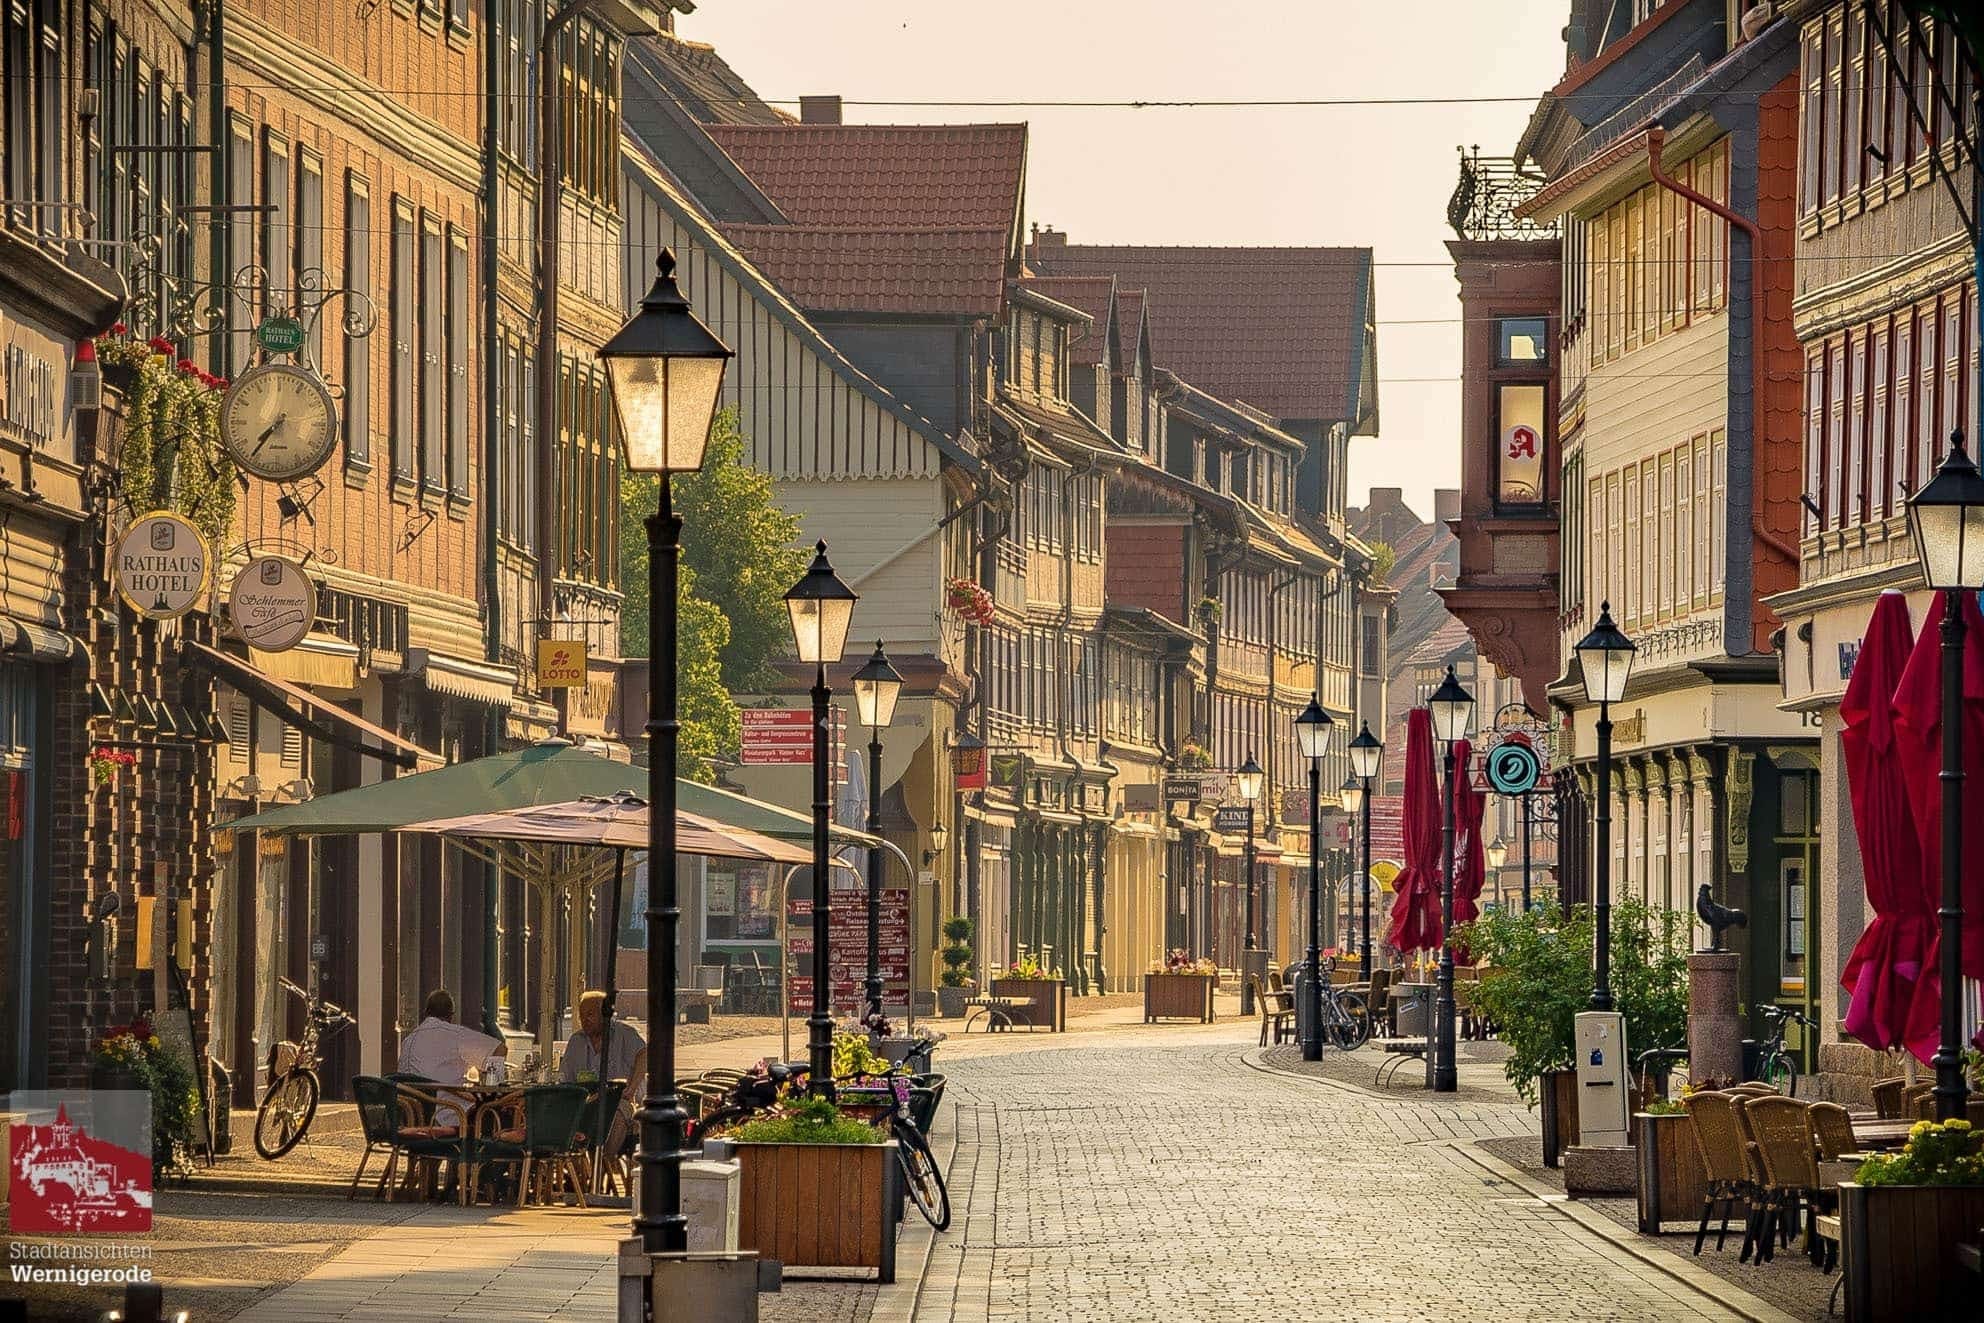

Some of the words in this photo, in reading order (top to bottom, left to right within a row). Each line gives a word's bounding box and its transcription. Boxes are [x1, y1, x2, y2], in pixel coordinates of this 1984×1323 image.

[265, 334, 295, 345] HOTEL
[123, 555, 201, 573] RATHAUS
[132, 574, 193, 592] HOTEL
[239, 594, 306, 606] Schlemmer
[543, 669, 580, 680] LOTTO
[1167, 785, 1198, 796] BONITA
[1201, 782, 1226, 796] mily
